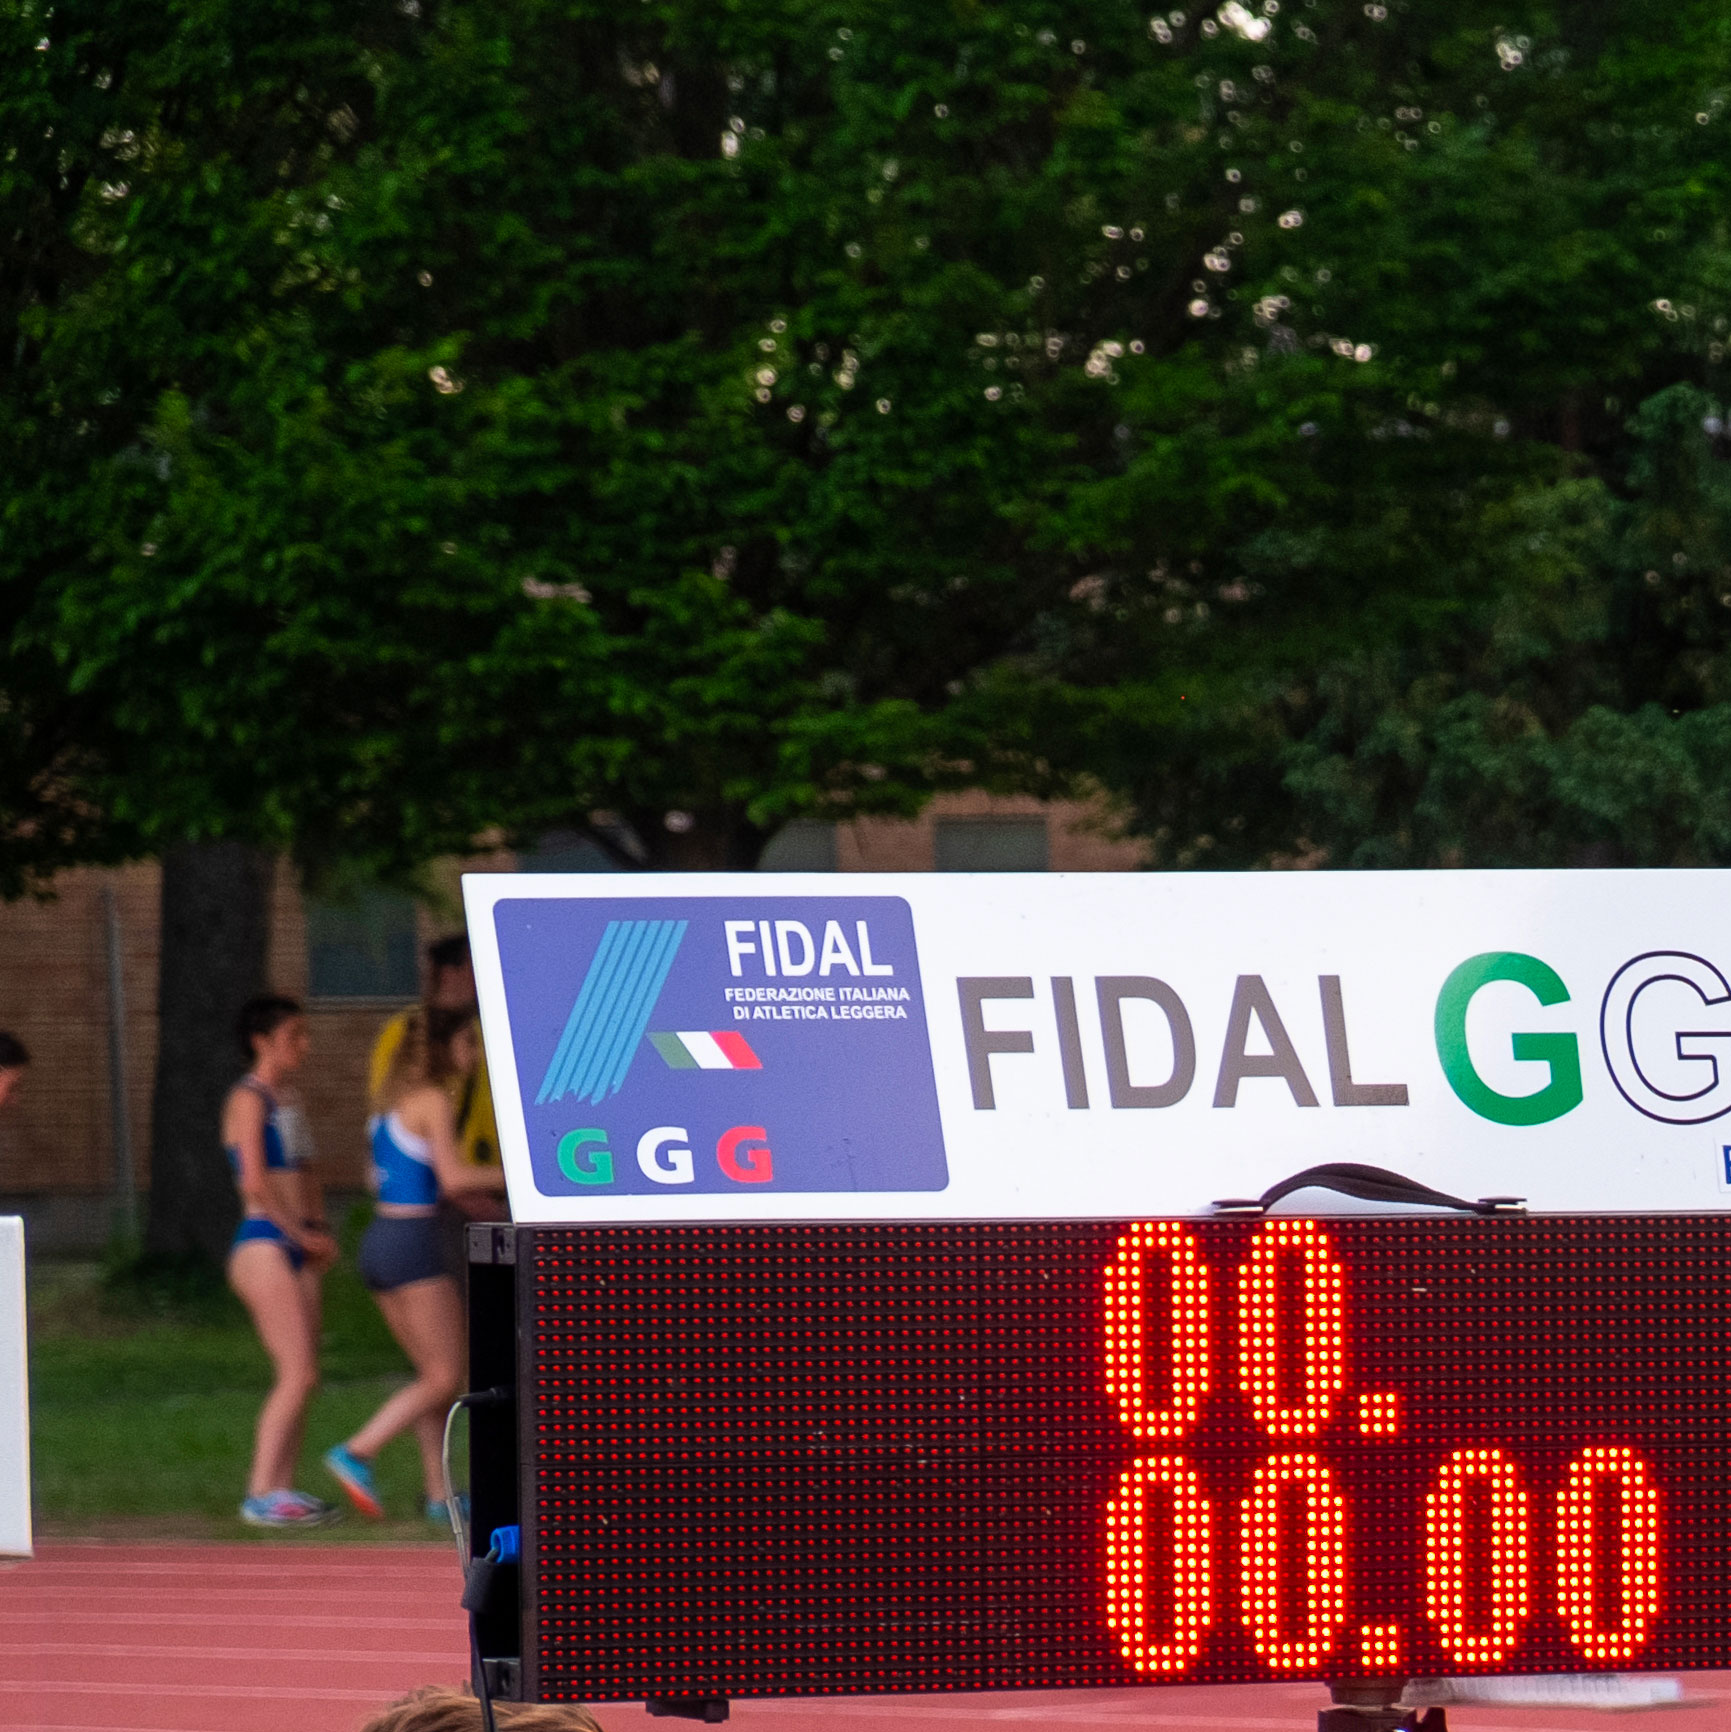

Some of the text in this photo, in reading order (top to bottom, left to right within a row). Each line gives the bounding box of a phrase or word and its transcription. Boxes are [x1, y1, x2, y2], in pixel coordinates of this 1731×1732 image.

[724, 919, 894, 977] FIDAL
[725, 986, 911, 1003] FEDERAZIONE ITALIANA
[733, 1005, 908, 1020] DI ATLETICA LEGGERA
[956, 973, 1410, 1110] FIDAL
[1104, 1445, 1660, 1673] 00.00
